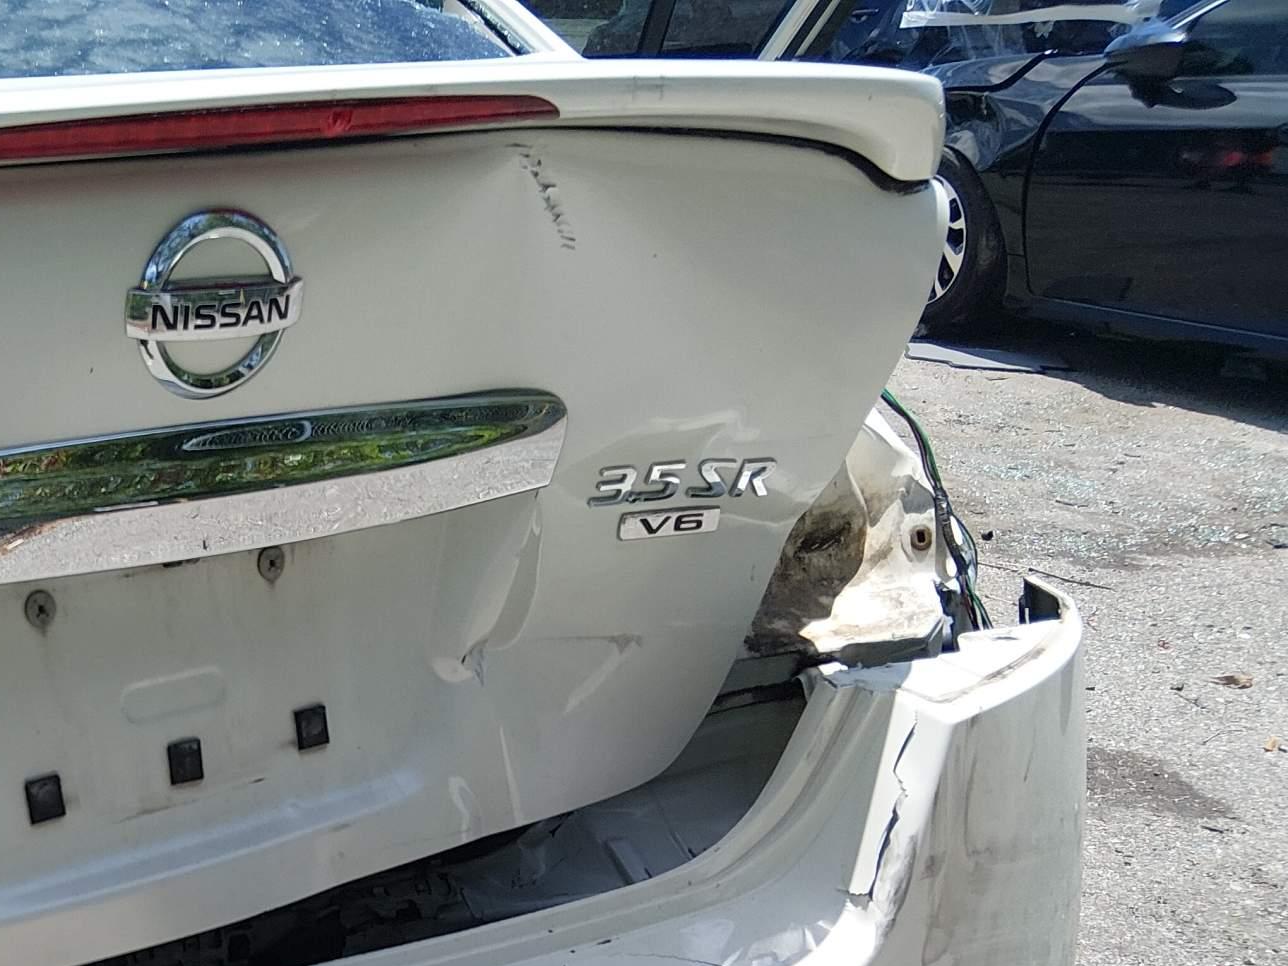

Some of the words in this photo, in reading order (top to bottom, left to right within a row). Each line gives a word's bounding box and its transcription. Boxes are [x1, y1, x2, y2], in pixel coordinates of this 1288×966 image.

[151, 294, 291, 331] NISSAN
[686, 457, 777, 497] SR
[639, 513, 704, 534] V6
